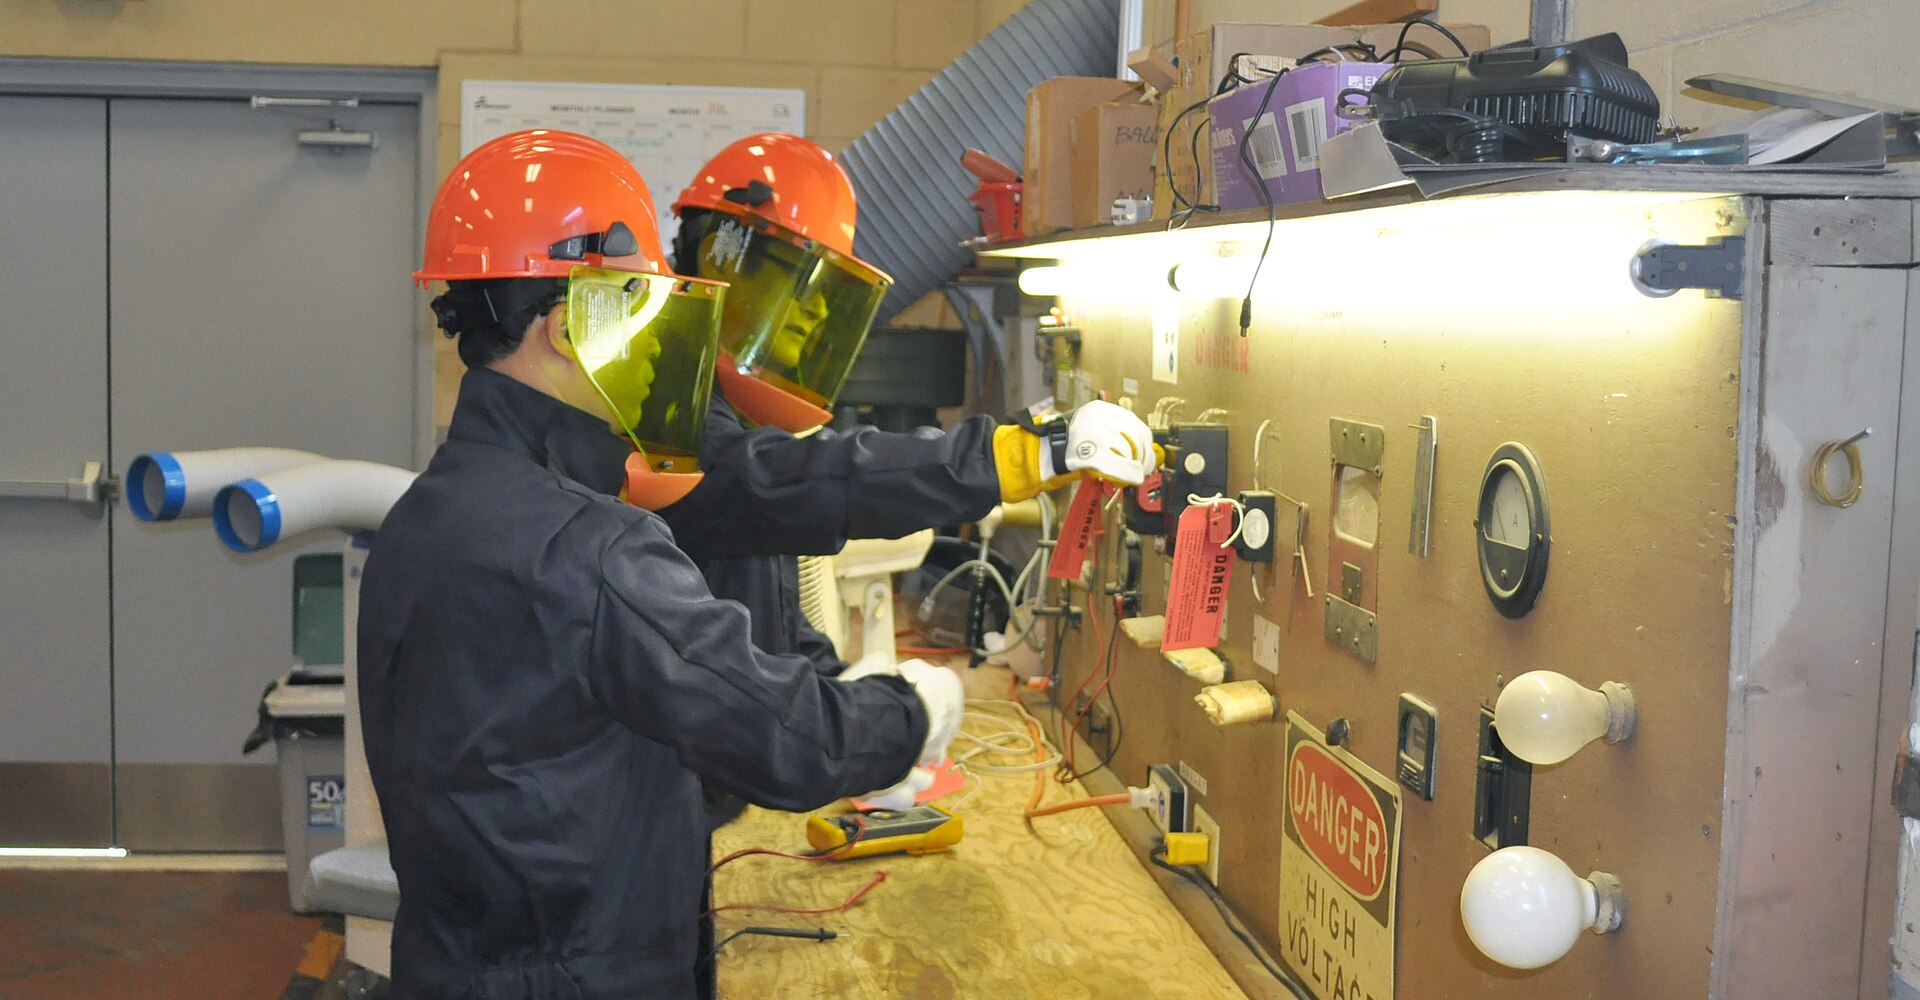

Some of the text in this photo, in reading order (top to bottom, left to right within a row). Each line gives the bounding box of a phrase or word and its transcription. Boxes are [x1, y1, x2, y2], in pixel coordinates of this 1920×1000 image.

[1195, 332, 1248, 374] DANGER
[1078, 499, 1099, 549] DANGER
[1512, 513, 1519, 528] A
[1206, 555, 1228, 613] DANGER
[1293, 759, 1380, 886] DANGER
[1305, 872, 1357, 959] HIGH
[1287, 910, 1378, 1000] VOLTAG
